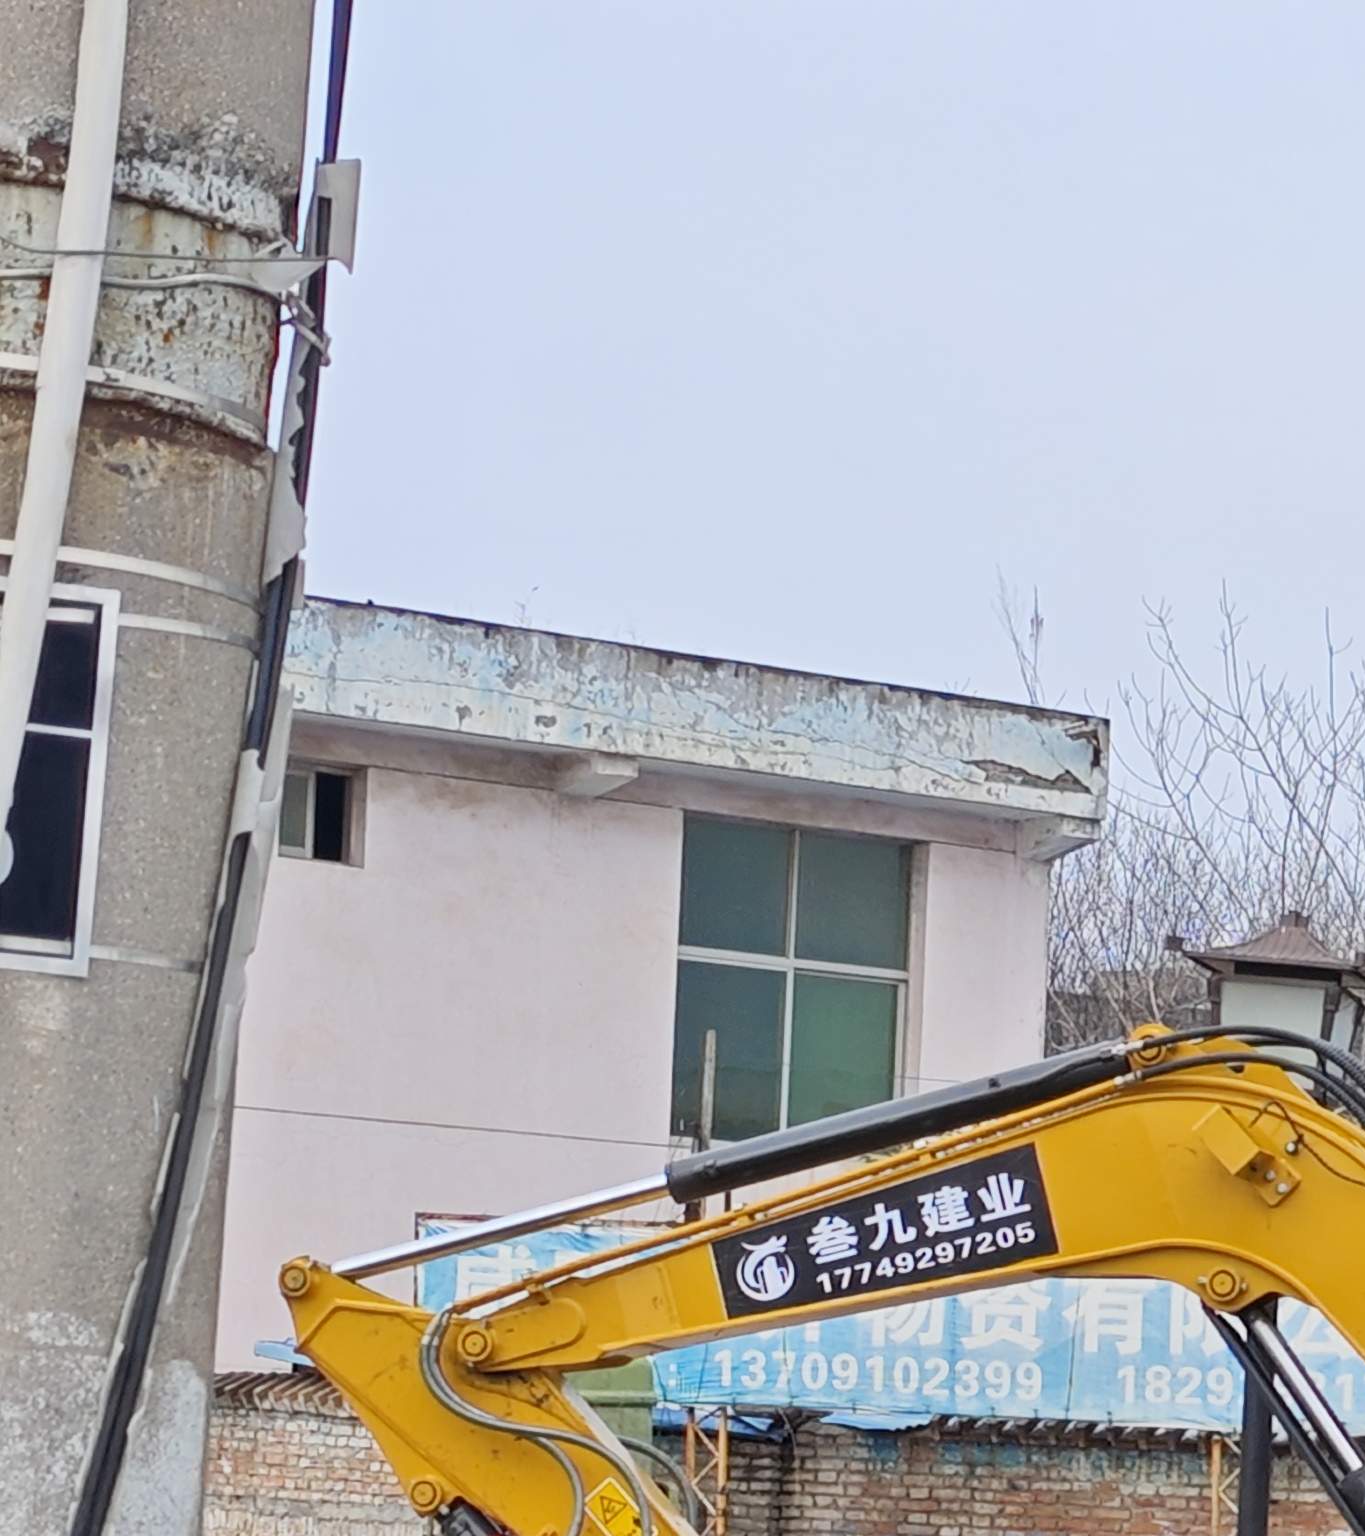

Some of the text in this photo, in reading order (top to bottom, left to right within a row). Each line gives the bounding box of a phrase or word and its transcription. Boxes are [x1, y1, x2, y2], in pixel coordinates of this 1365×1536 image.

[806, 1173, 1032, 1264] 叁九建业
[816, 1222, 1036, 1293] 17749297205
[713, 1349, 1043, 1401] 13709102399
